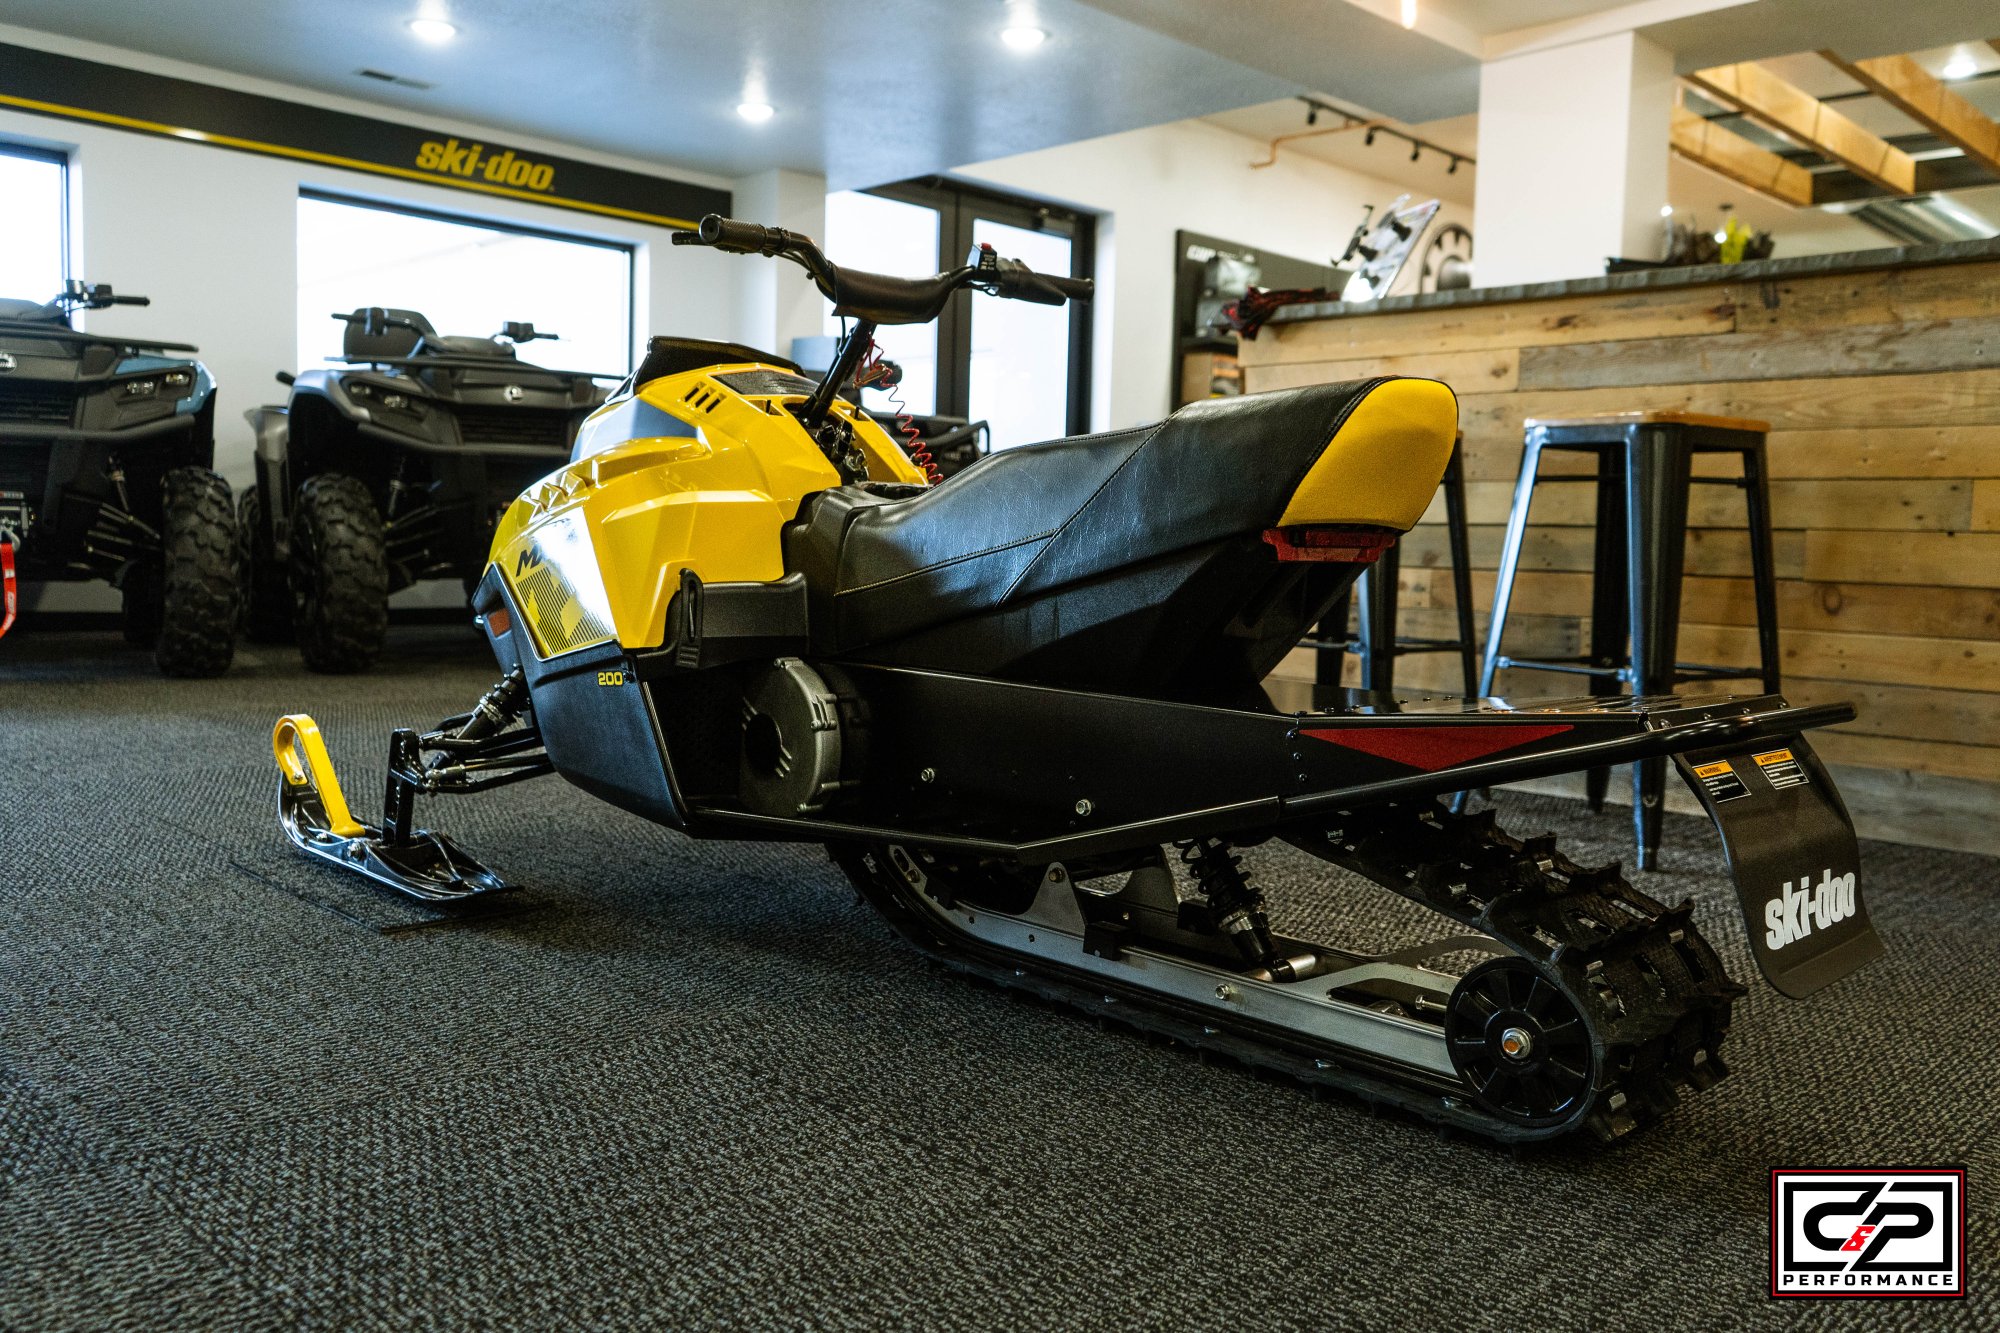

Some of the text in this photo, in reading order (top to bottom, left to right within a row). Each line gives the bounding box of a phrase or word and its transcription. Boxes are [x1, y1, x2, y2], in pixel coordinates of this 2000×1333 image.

[415, 139, 555, 191] ski-doo
[597, 671, 623, 686] 200
[1765, 868, 1856, 951] ski-doo
